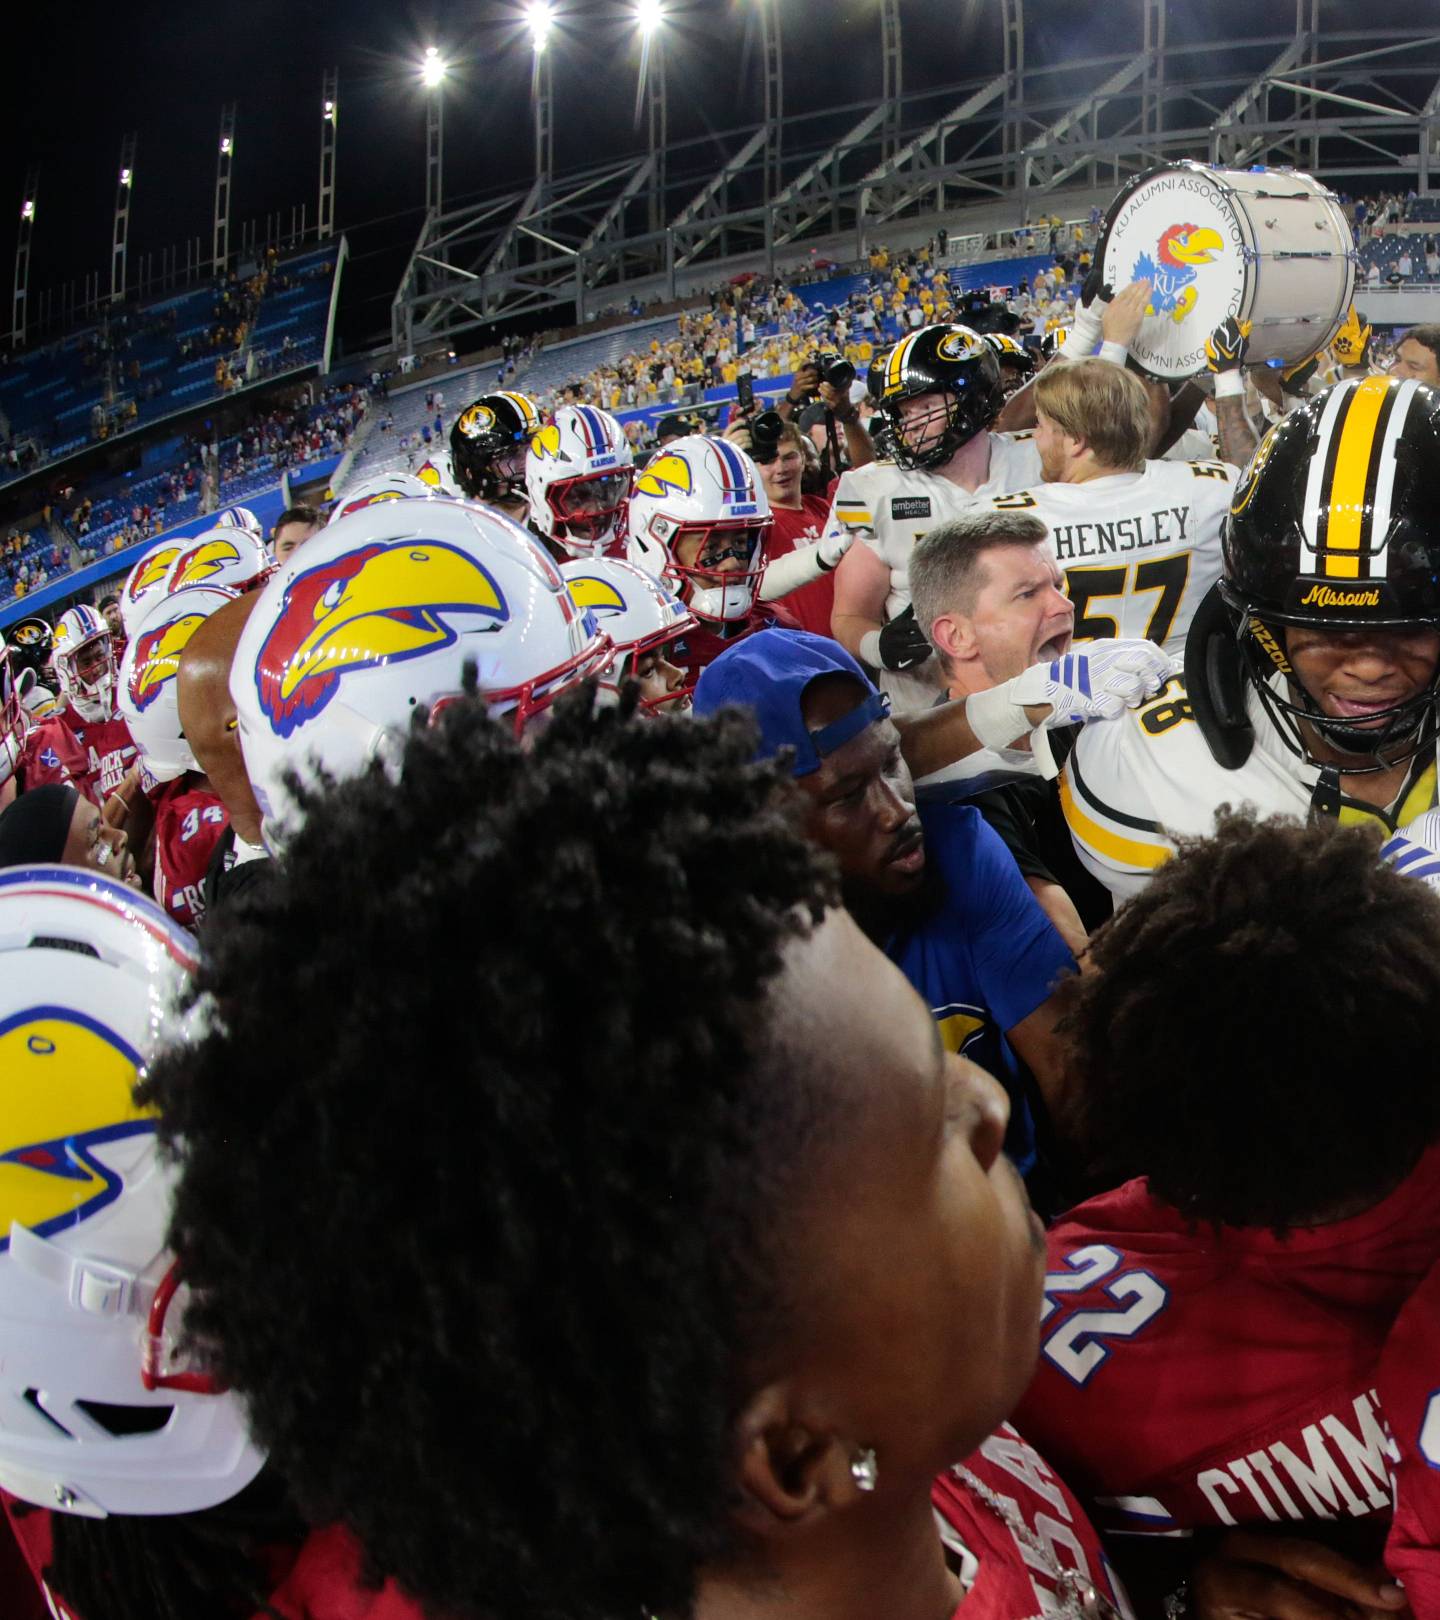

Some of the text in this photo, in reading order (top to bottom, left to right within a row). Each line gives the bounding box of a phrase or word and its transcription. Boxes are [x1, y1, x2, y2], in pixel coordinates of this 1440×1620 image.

[1114, 177, 1244, 257] KU ALUMNI ASSOCIATION
[1153, 274, 1177, 296] KU
[892, 497, 930, 512] ambetter
[1053, 506, 1190, 560] HENSLEY
[1065, 549, 1194, 647] 57
[1301, 584, 1380, 608] Missouri
[1040, 1243, 1172, 1392] 22
[1196, 1388, 1401, 1526] CUMM
